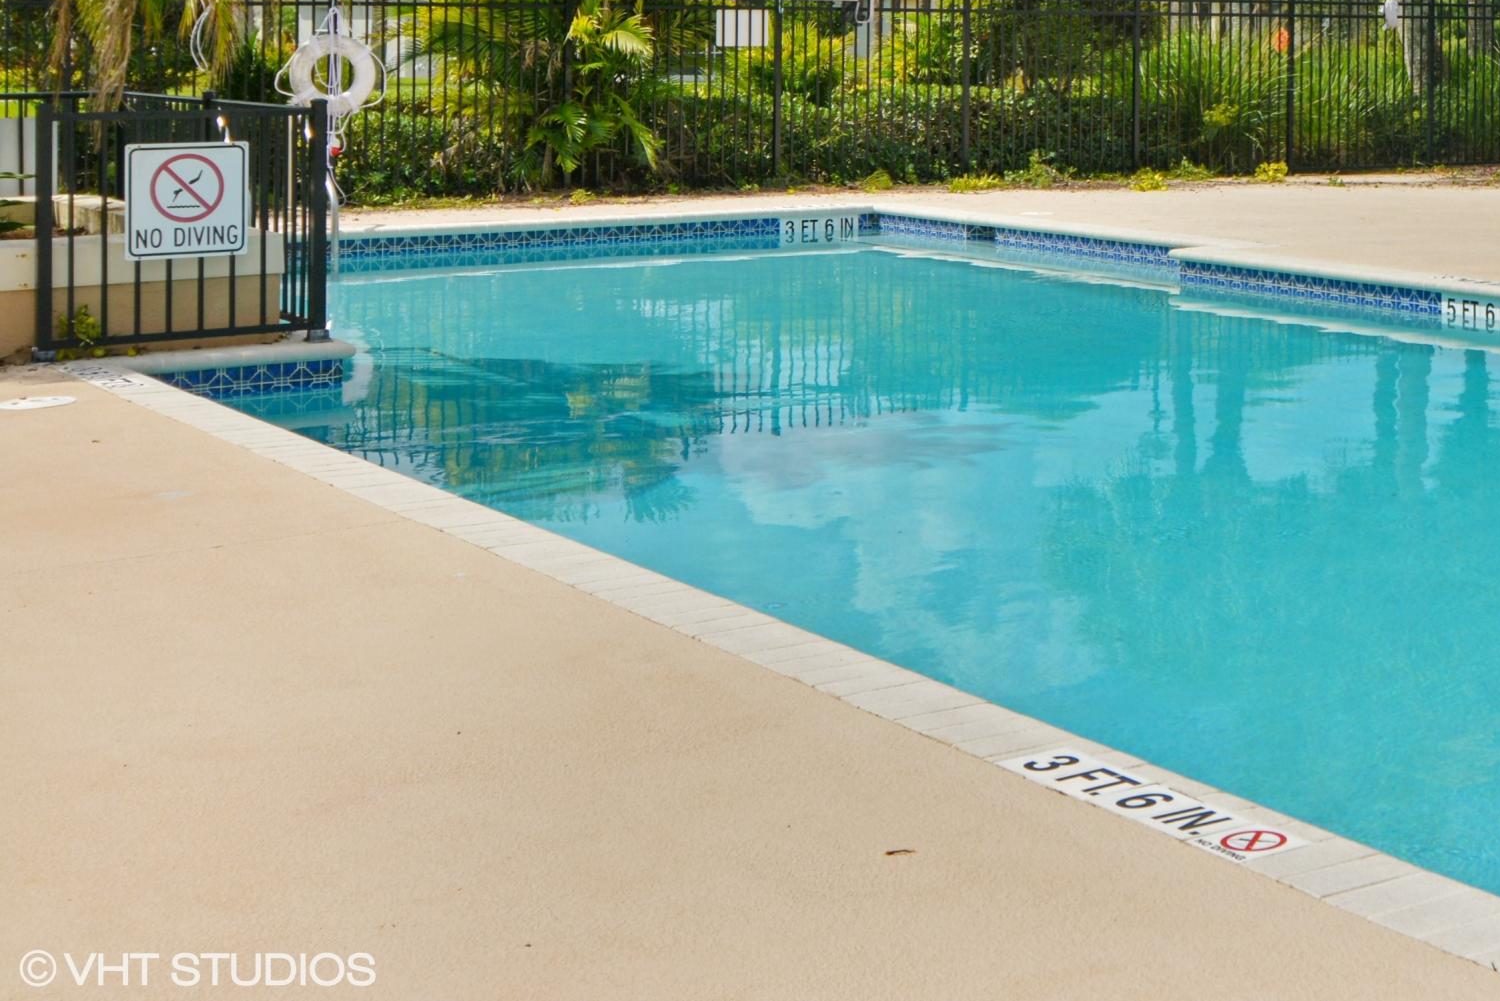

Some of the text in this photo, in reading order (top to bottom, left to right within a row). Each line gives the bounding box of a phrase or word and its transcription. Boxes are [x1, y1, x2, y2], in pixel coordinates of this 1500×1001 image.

[136, 225, 239, 249] NO DIVING
[1023, 755, 1233, 835] 3 FT. 6 IN.
[1195, 839, 1247, 861] NO DIVING
